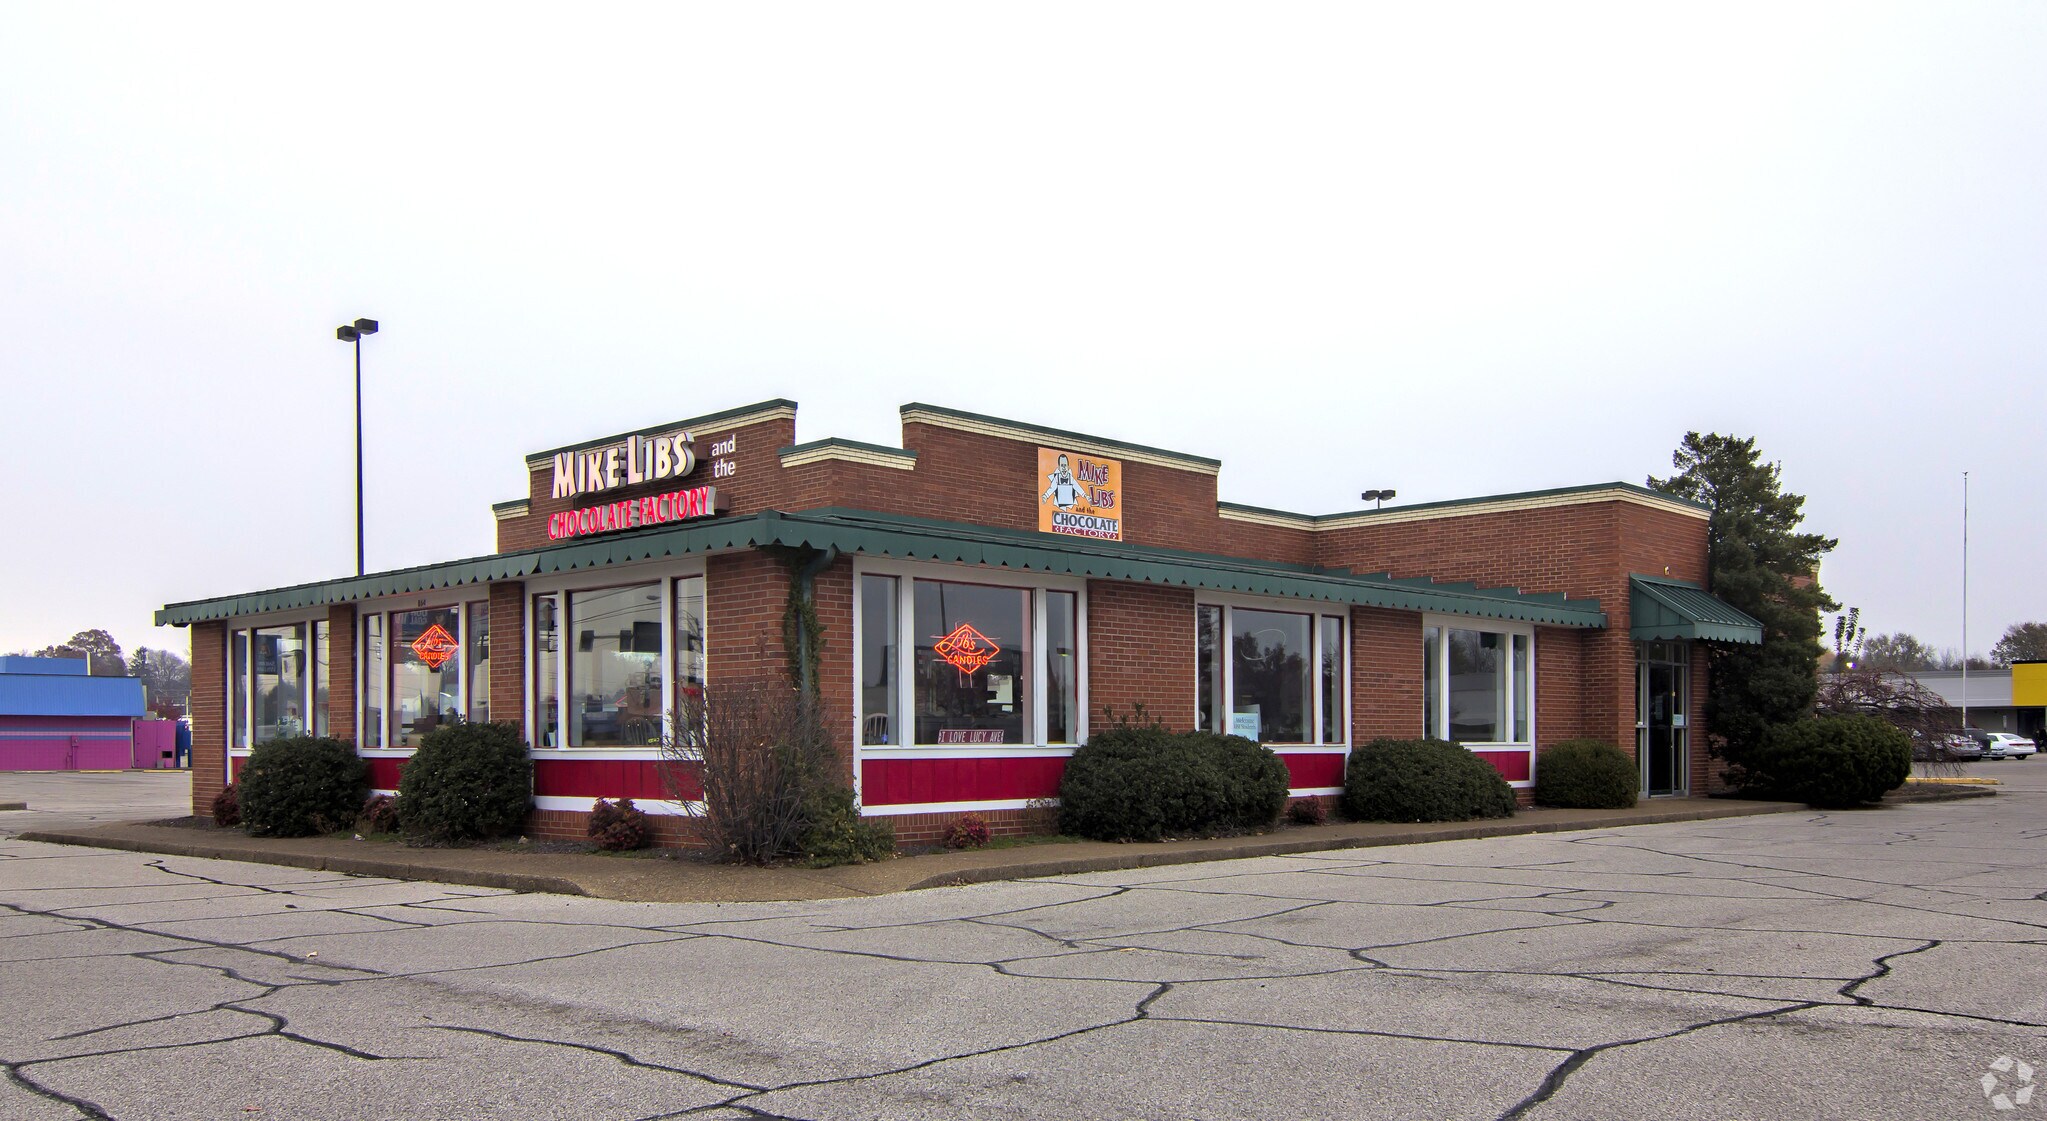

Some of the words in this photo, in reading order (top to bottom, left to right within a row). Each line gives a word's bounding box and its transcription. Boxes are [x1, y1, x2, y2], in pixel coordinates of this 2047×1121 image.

[711, 434, 736, 457] and
[552, 447, 626, 499] MIKE
[713, 459, 736, 478] the
[1077, 459, 1109, 486] MIKE
[548, 500, 638, 540] CHOCOLATE
[639, 485, 717, 526] FACTORY
[1086, 507, 1095, 515] the
[1053, 512, 1118, 532] CHOCOLATE
[941, 731, 946, 743] I
[949, 731, 967, 743] LOVE
[969, 731, 987, 743] LUCY
